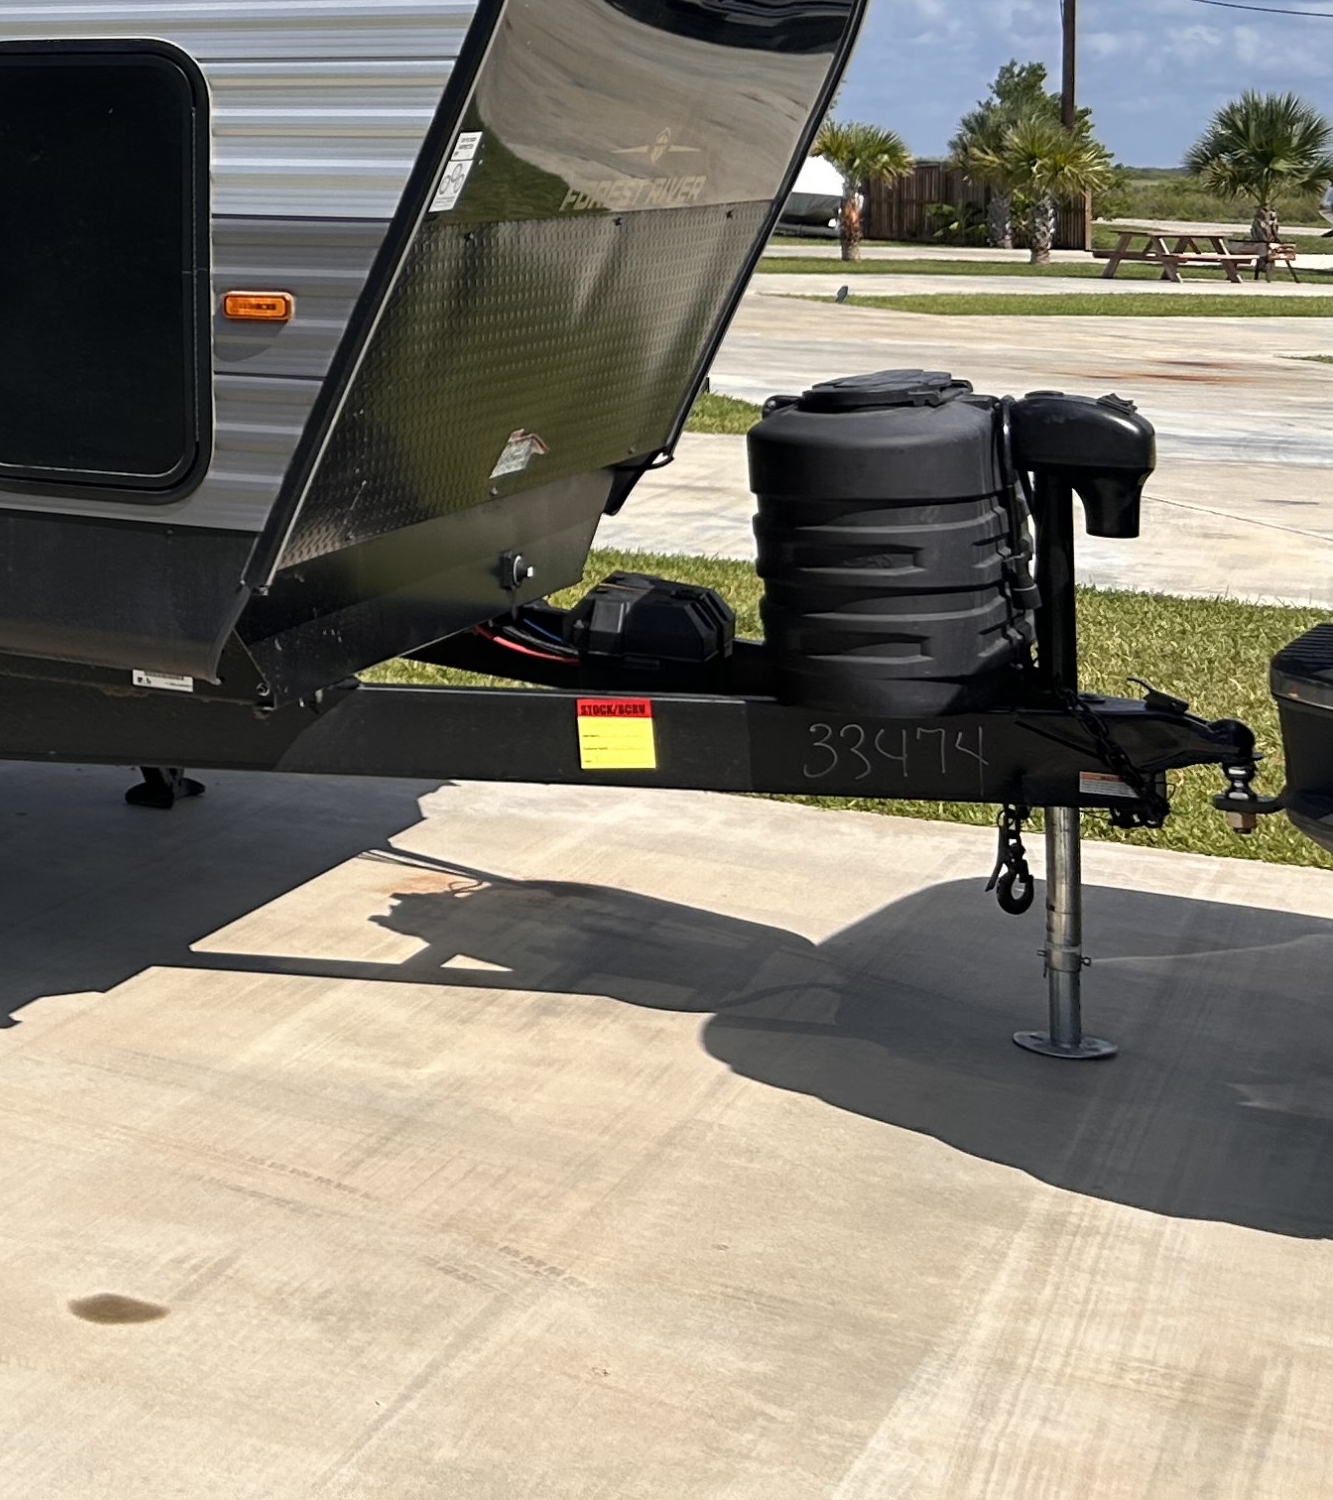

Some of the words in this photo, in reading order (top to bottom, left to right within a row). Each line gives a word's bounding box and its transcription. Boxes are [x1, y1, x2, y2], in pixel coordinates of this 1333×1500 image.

[559, 178, 652, 211] FOREST
[646, 175, 707, 204] RIVER
[803, 723, 988, 796] 33474
